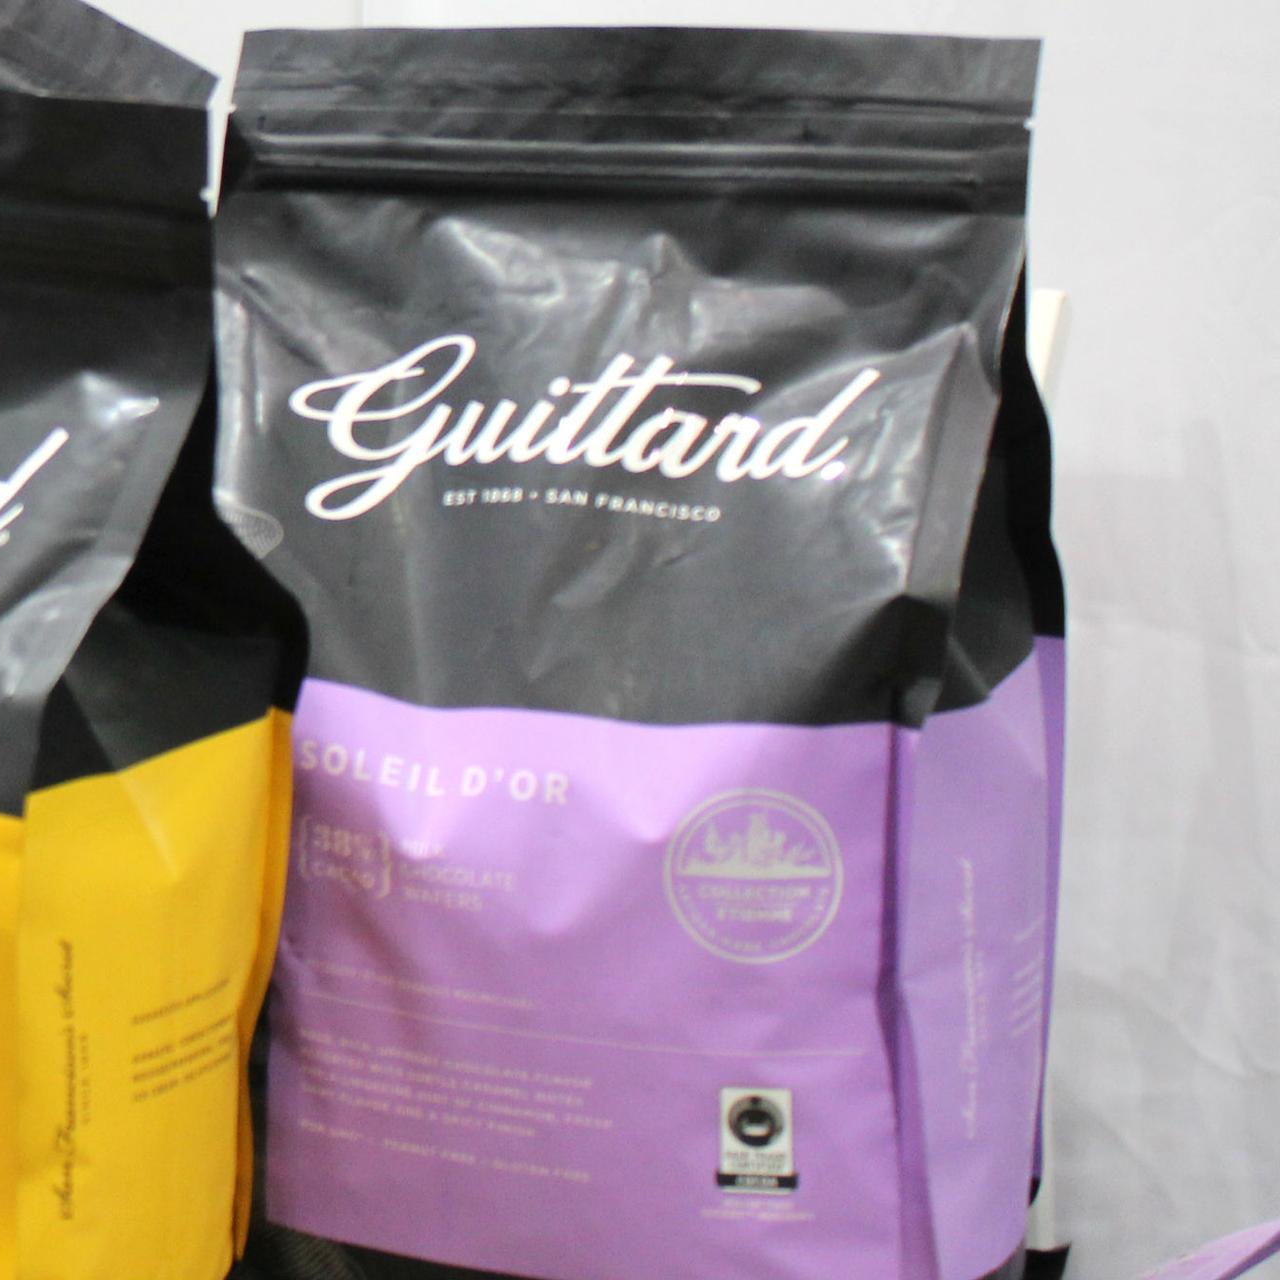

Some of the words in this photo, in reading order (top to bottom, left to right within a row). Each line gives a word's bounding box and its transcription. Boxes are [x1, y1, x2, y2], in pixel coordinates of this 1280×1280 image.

[442, 489, 476, 507] EST
[544, 488, 588, 506] SAN
[594, 492, 721, 522] FRANCISCO
[299, 740, 446, 797] SOLEIL
